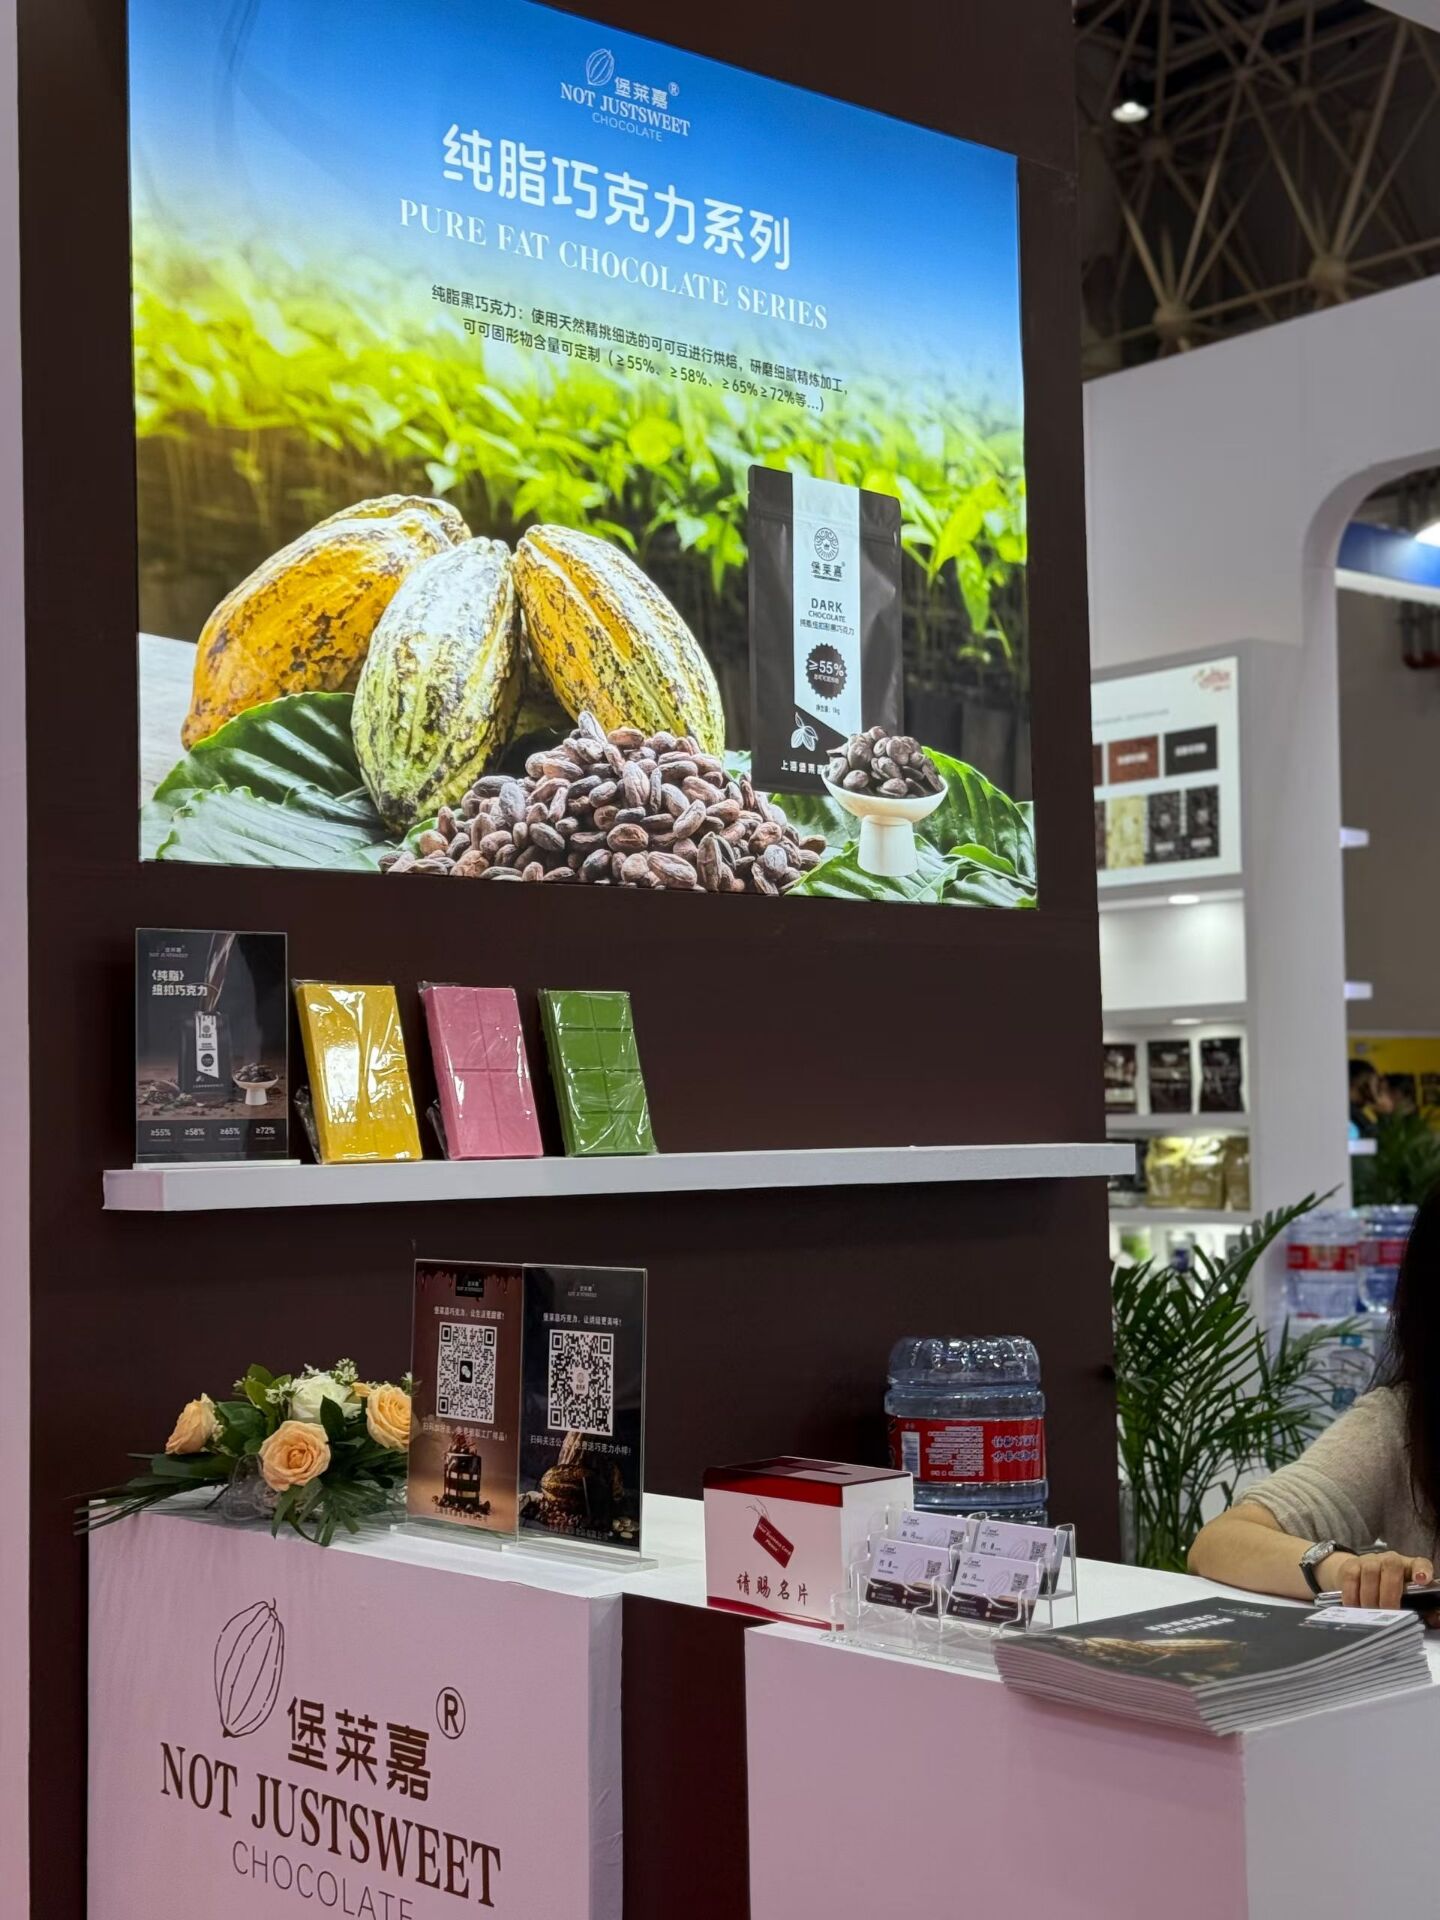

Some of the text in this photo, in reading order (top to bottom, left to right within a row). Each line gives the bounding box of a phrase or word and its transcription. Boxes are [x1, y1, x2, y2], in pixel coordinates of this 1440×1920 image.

[560, 82, 691, 137] NOT JUSTSWEET
[613, 76, 669, 111] 堡莱嘉
[591, 111, 662, 142] CHOCOLATE
[442, 123, 791, 270] 纯脂巧克力系列
[399, 197, 828, 329] PURE FAT CHOCOLATE SERIES
[808, 610, 846, 623] CHOCOLATE
[811, 597, 843, 613] DARK
[808, 659, 845, 677] ≥55%
[151, 969, 185, 982] 《纯脂》
[151, 985, 208, 997] 纽扣巧克力
[255, 1126, 276, 1135] ≥72%
[736, 1571, 809, 1606] 请赐名片
[286, 1696, 431, 1802] 堡莱嘉
[160, 1742, 502, 1908] NOT JUSTSWEET
[232, 1840, 414, 1920] CHOCOLATE
